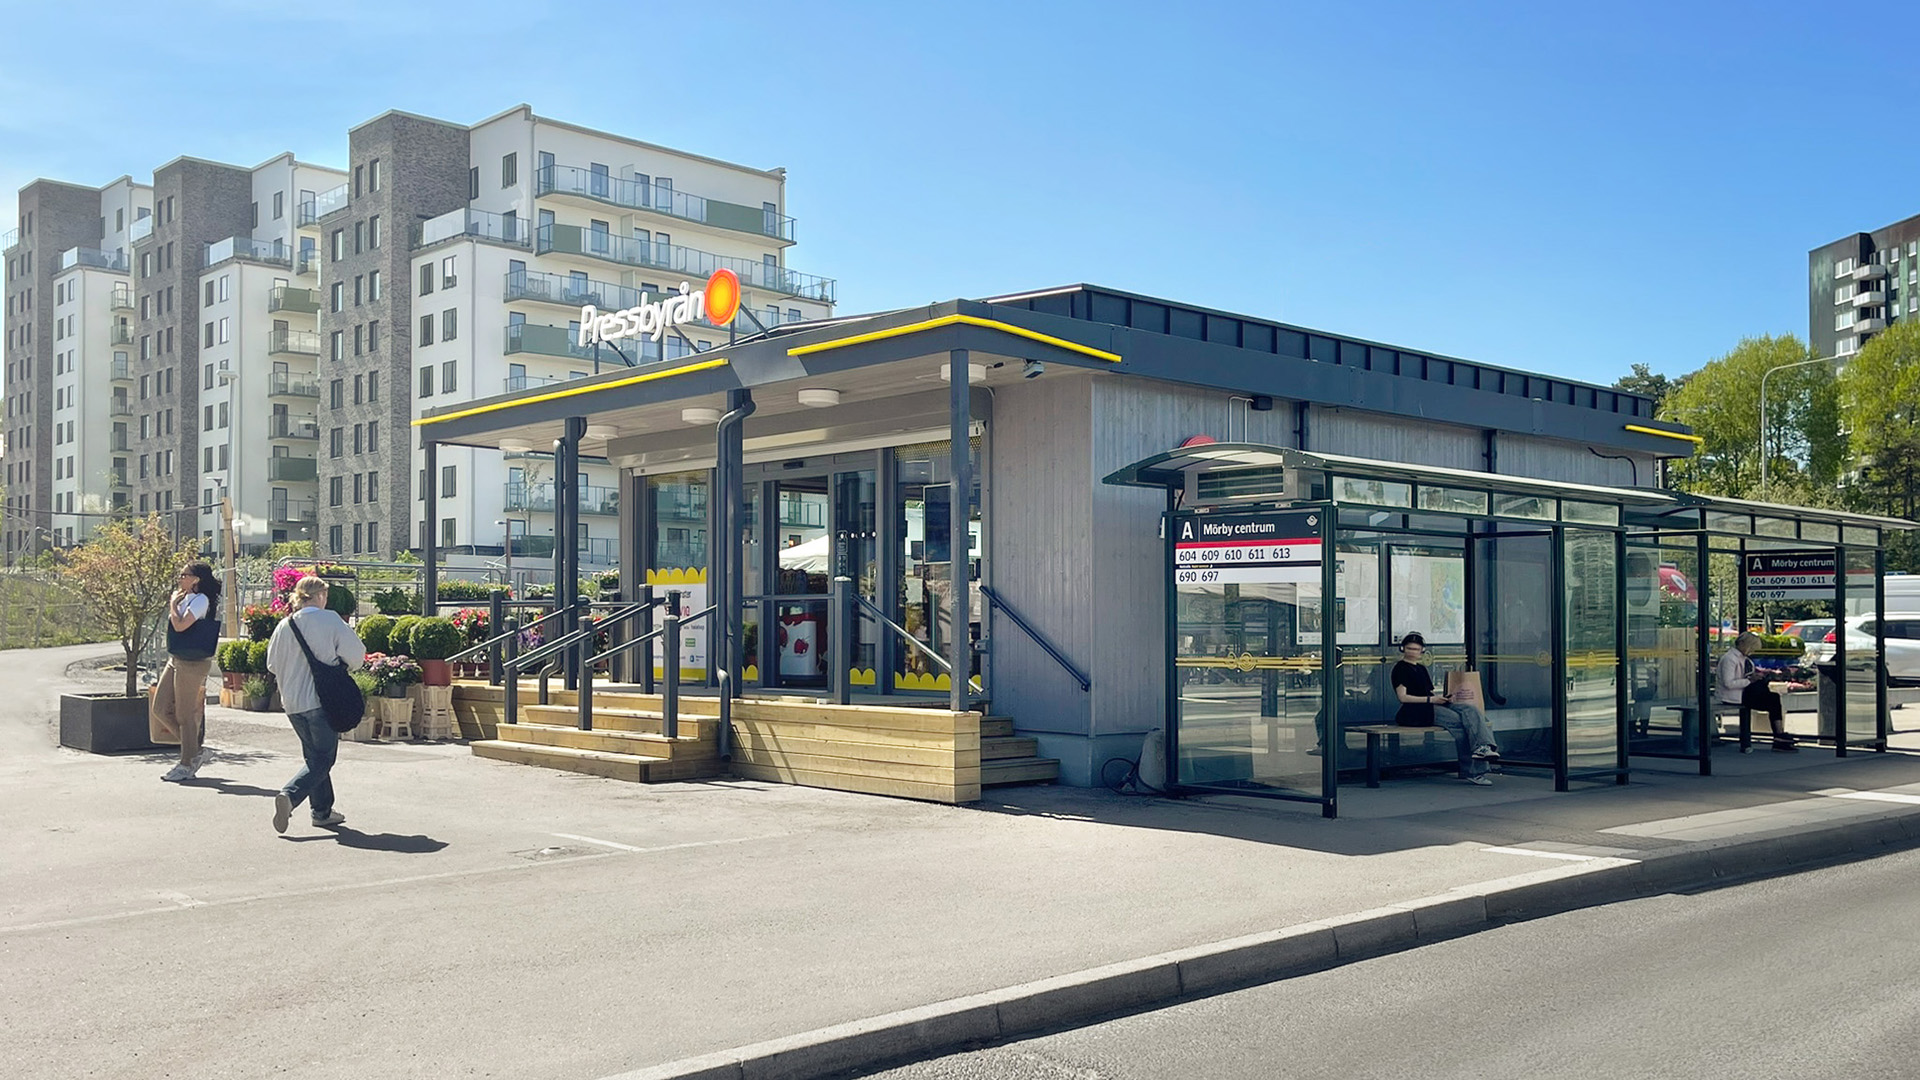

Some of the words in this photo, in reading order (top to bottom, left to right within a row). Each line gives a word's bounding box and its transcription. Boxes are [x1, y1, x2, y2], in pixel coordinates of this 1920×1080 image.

[579, 281, 704, 347] Pressbyrån
[1181, 521, 1194, 540] A
[1203, 523, 1233, 537] Mörby
[1234, 522, 1275, 534] centrum
[1179, 551, 1197, 561] 604
[1201, 550, 1220, 561] 609
[1224, 549, 1242, 560] 610
[1248, 549, 1265, 559] 611
[1272, 548, 1291, 559] 613
[1752, 558, 1763, 570] A
[1771, 559, 1798, 569] Mörby
[1799, 559, 1835, 567] centrum
[1179, 571, 1197, 582] 690
[1201, 571, 1219, 582] 697
[1750, 577, 1766, 585] 604
[1770, 577, 1786, 585] 609
[1790, 576, 1806, 584] 610
[1811, 576, 1826, 584] 611
[1750, 591, 1766, 599] 690
